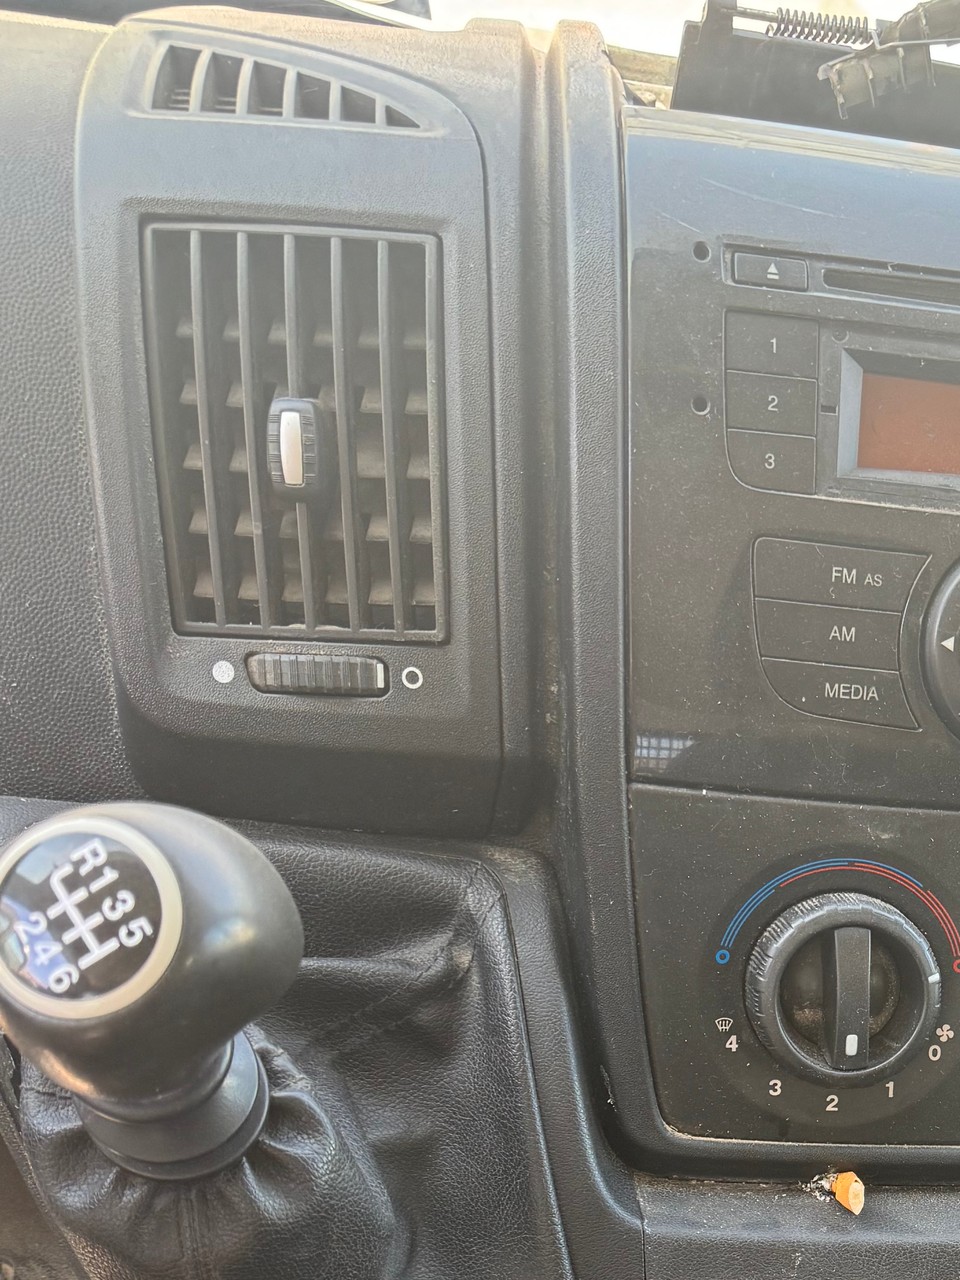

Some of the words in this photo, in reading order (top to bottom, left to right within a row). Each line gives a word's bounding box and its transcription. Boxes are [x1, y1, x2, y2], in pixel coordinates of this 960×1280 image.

[770, 337, 777, 354] 1
[767, 394, 779, 412] 2
[764, 452, 775, 470] 3
[831, 566, 857, 585] FM
[863, 573, 883, 587] AS
[828, 625, 856, 642] AM
[824, 682, 879, 701] MEDIA
[70, 837, 108, 877] R
[89, 865, 120, 894] 1
[101, 889, 136, 922] 3
[13, 910, 48, 943] 2
[117, 915, 154, 948] 5
[33, 940, 64, 966] 4
[47, 962, 80, 995] 6
[725, 1034, 739, 1052] 4
[928, 1043, 943, 1062] 0
[768, 1079, 782, 1096] 3
[885, 1081, 895, 1098] 1
[825, 1094, 839, 1112] 2
